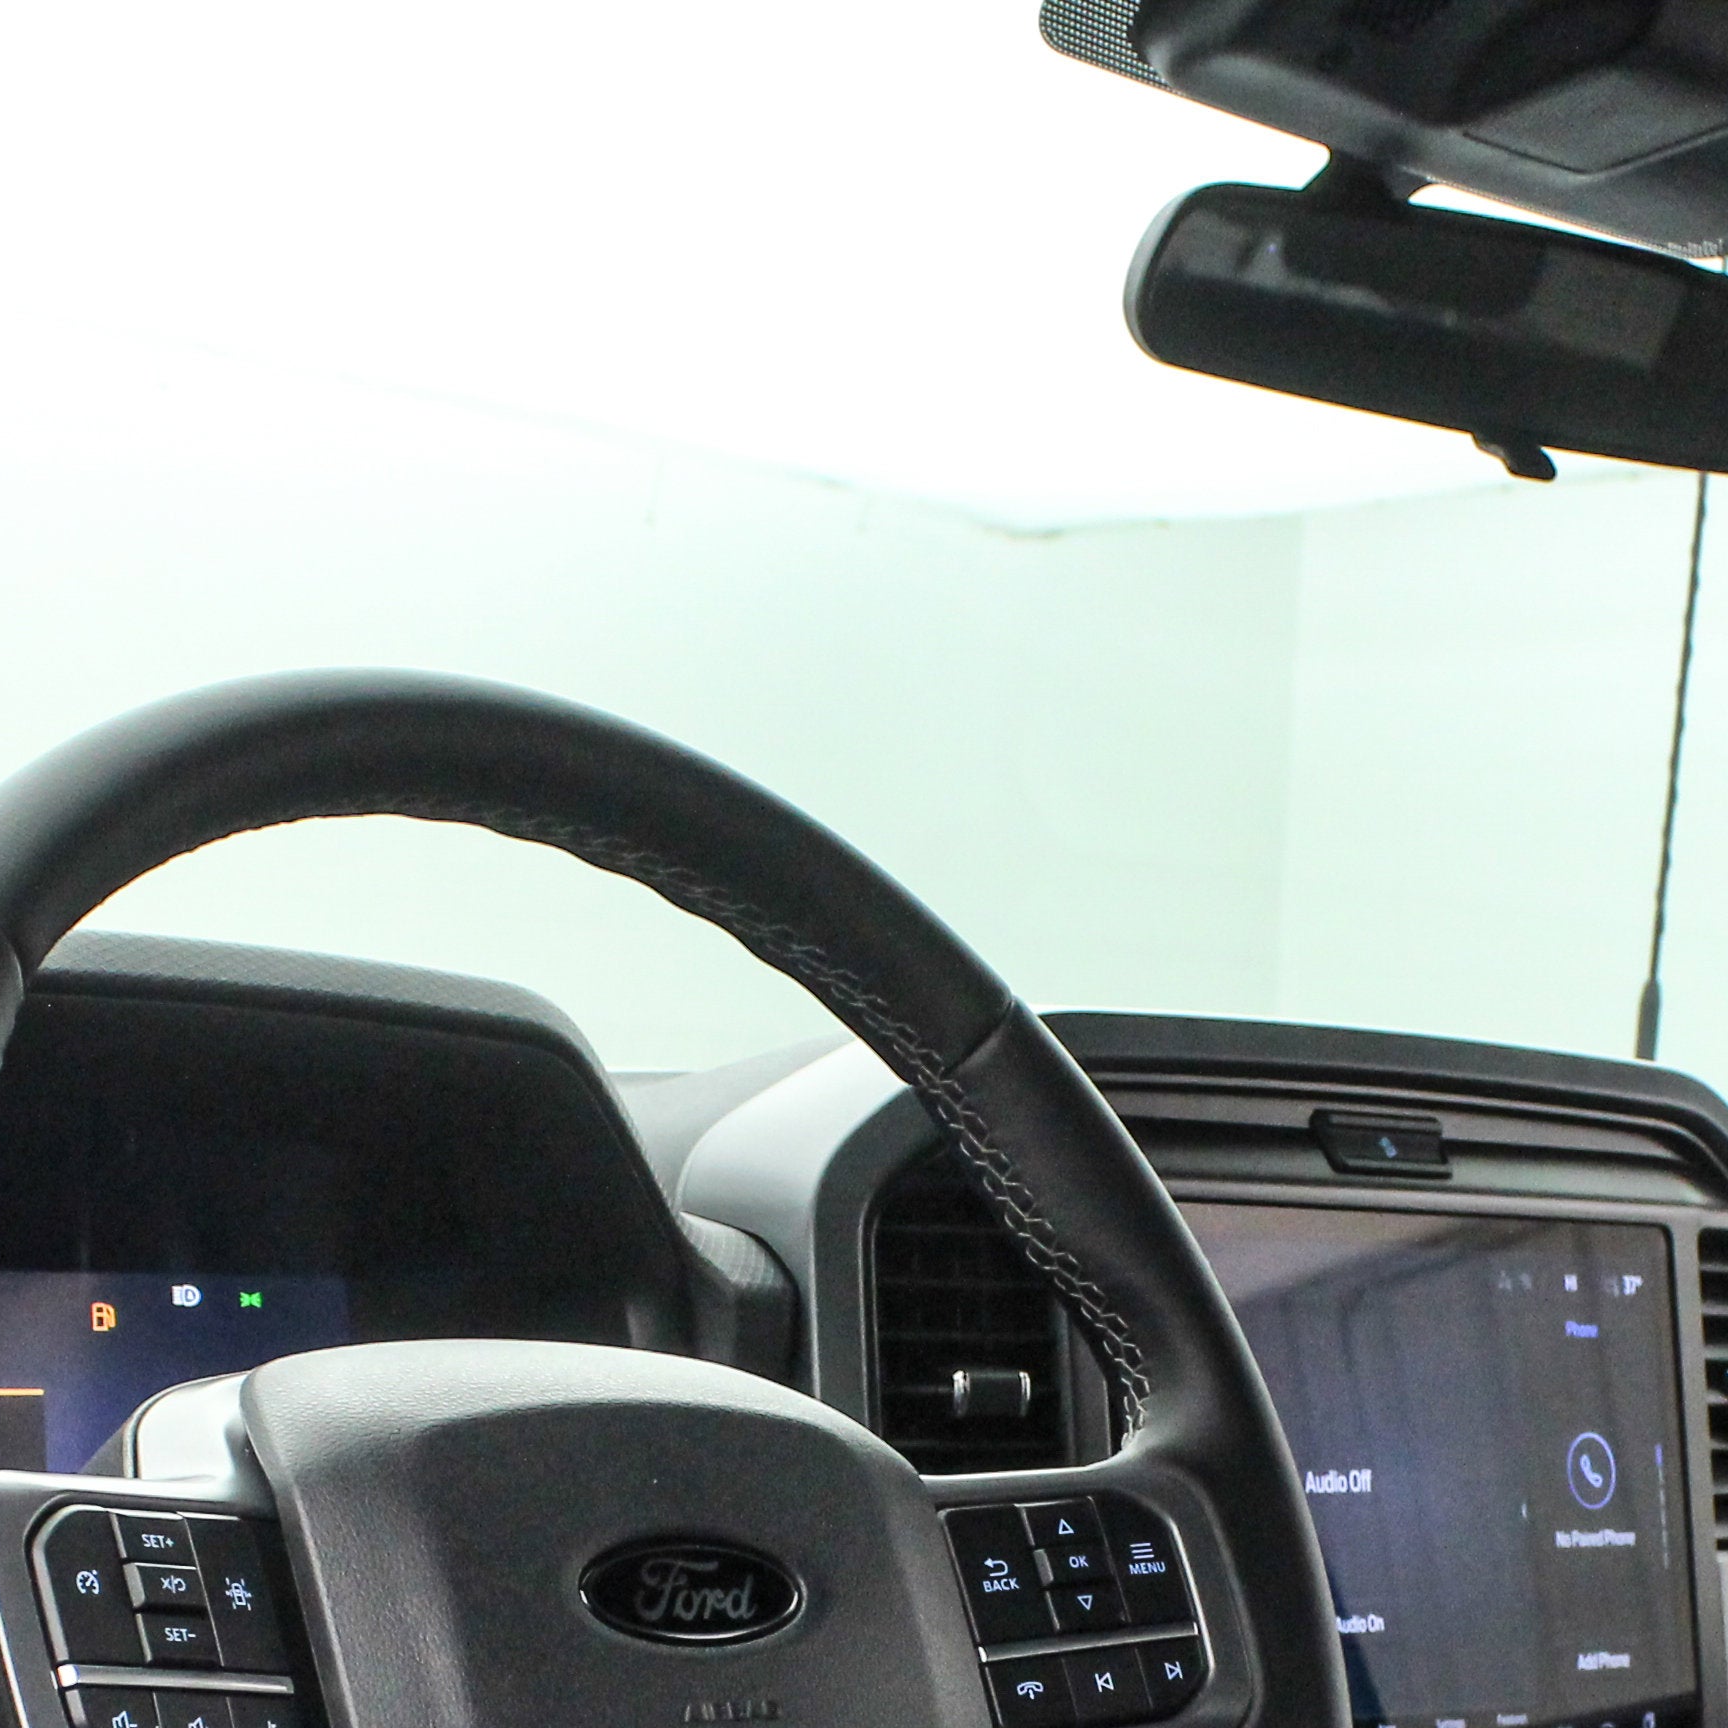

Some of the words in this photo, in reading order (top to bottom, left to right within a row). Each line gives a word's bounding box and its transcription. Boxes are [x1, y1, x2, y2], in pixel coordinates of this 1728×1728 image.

[1565, 1320, 1599, 1339] Phone
[1305, 1470, 1348, 1493] Audio
[1349, 1469, 1373, 1493] Off
[142, 1534, 174, 1548] SET+
[1069, 1556, 1089, 1568] OK
[1129, 1562, 1166, 1575] MENU
[634, 1557, 759, 1622] Ford
[983, 1578, 1020, 1593] BACK
[1368, 1613, 1386, 1633] On
[1599, 1651, 1631, 1669] Phone
